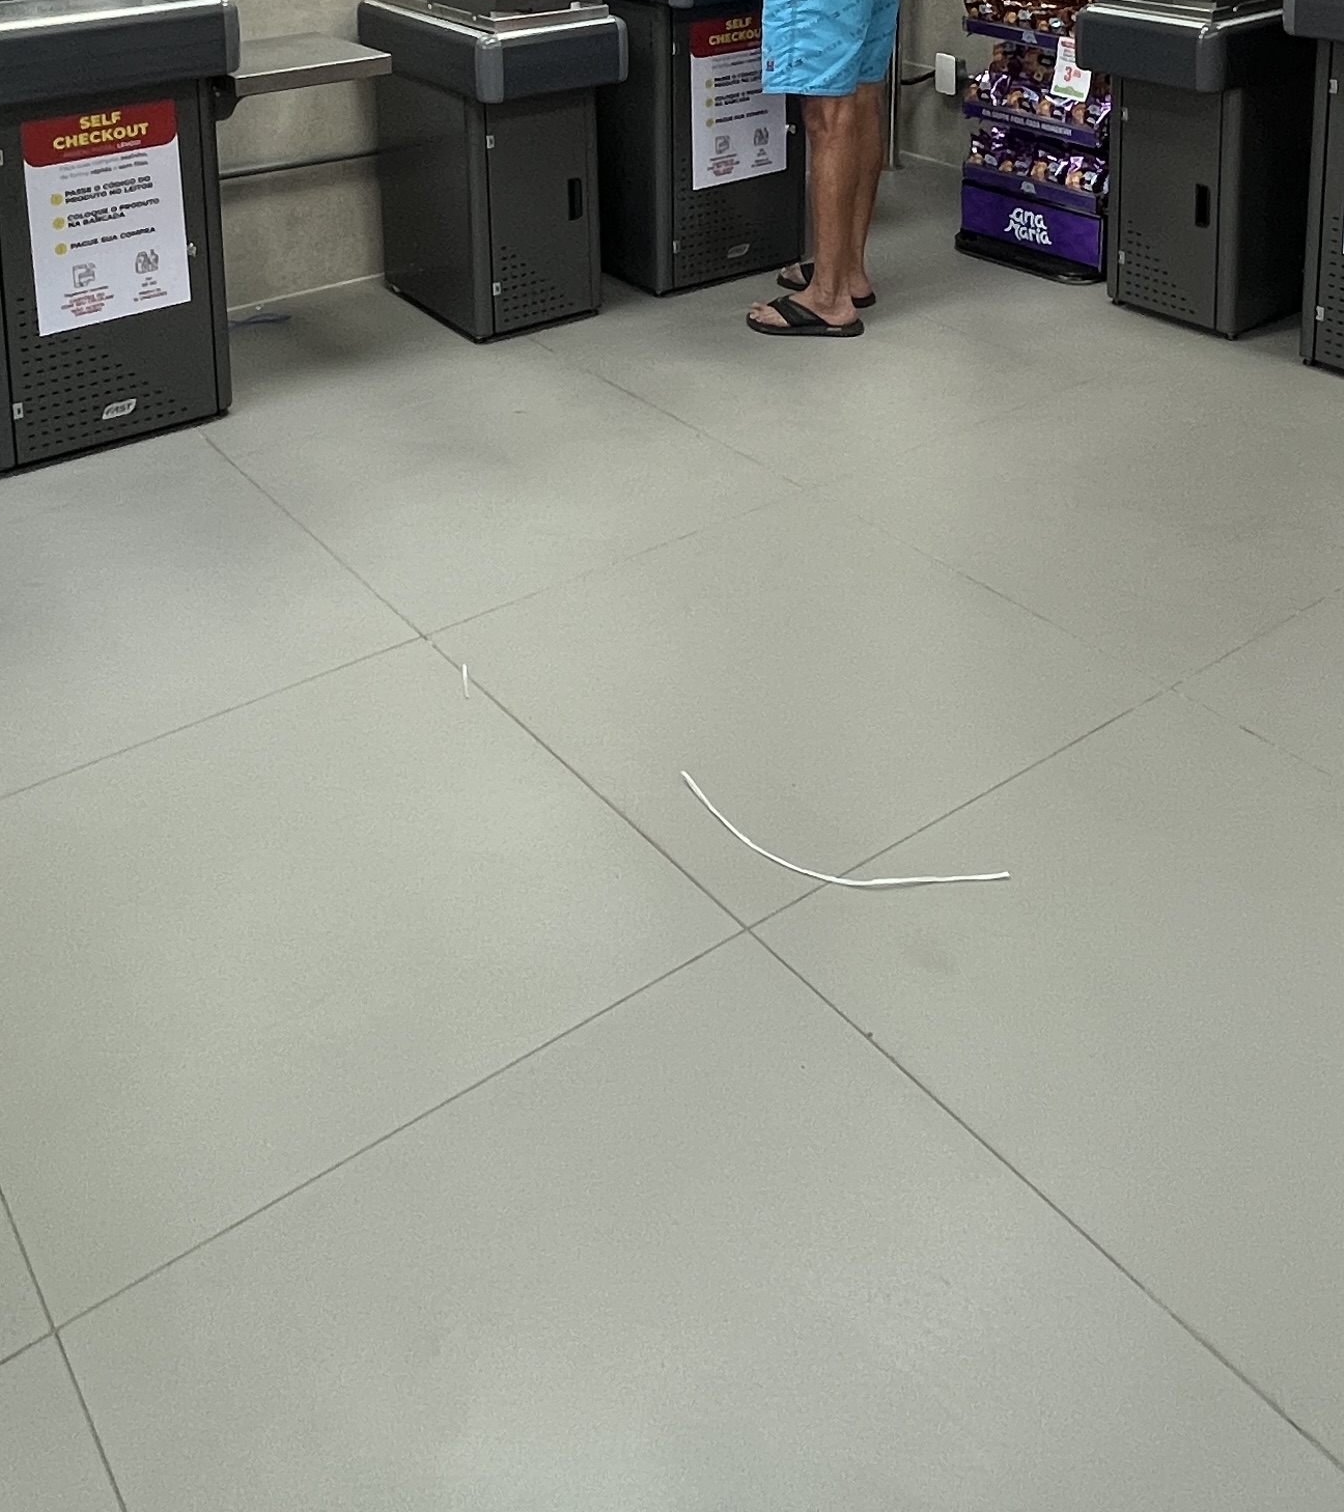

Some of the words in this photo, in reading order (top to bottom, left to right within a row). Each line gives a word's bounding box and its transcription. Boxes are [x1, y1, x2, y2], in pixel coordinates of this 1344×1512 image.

[725, 17, 752, 30] SELF
[79, 111, 122, 130] SELF
[52, 122, 149, 150] CHECKOUT
